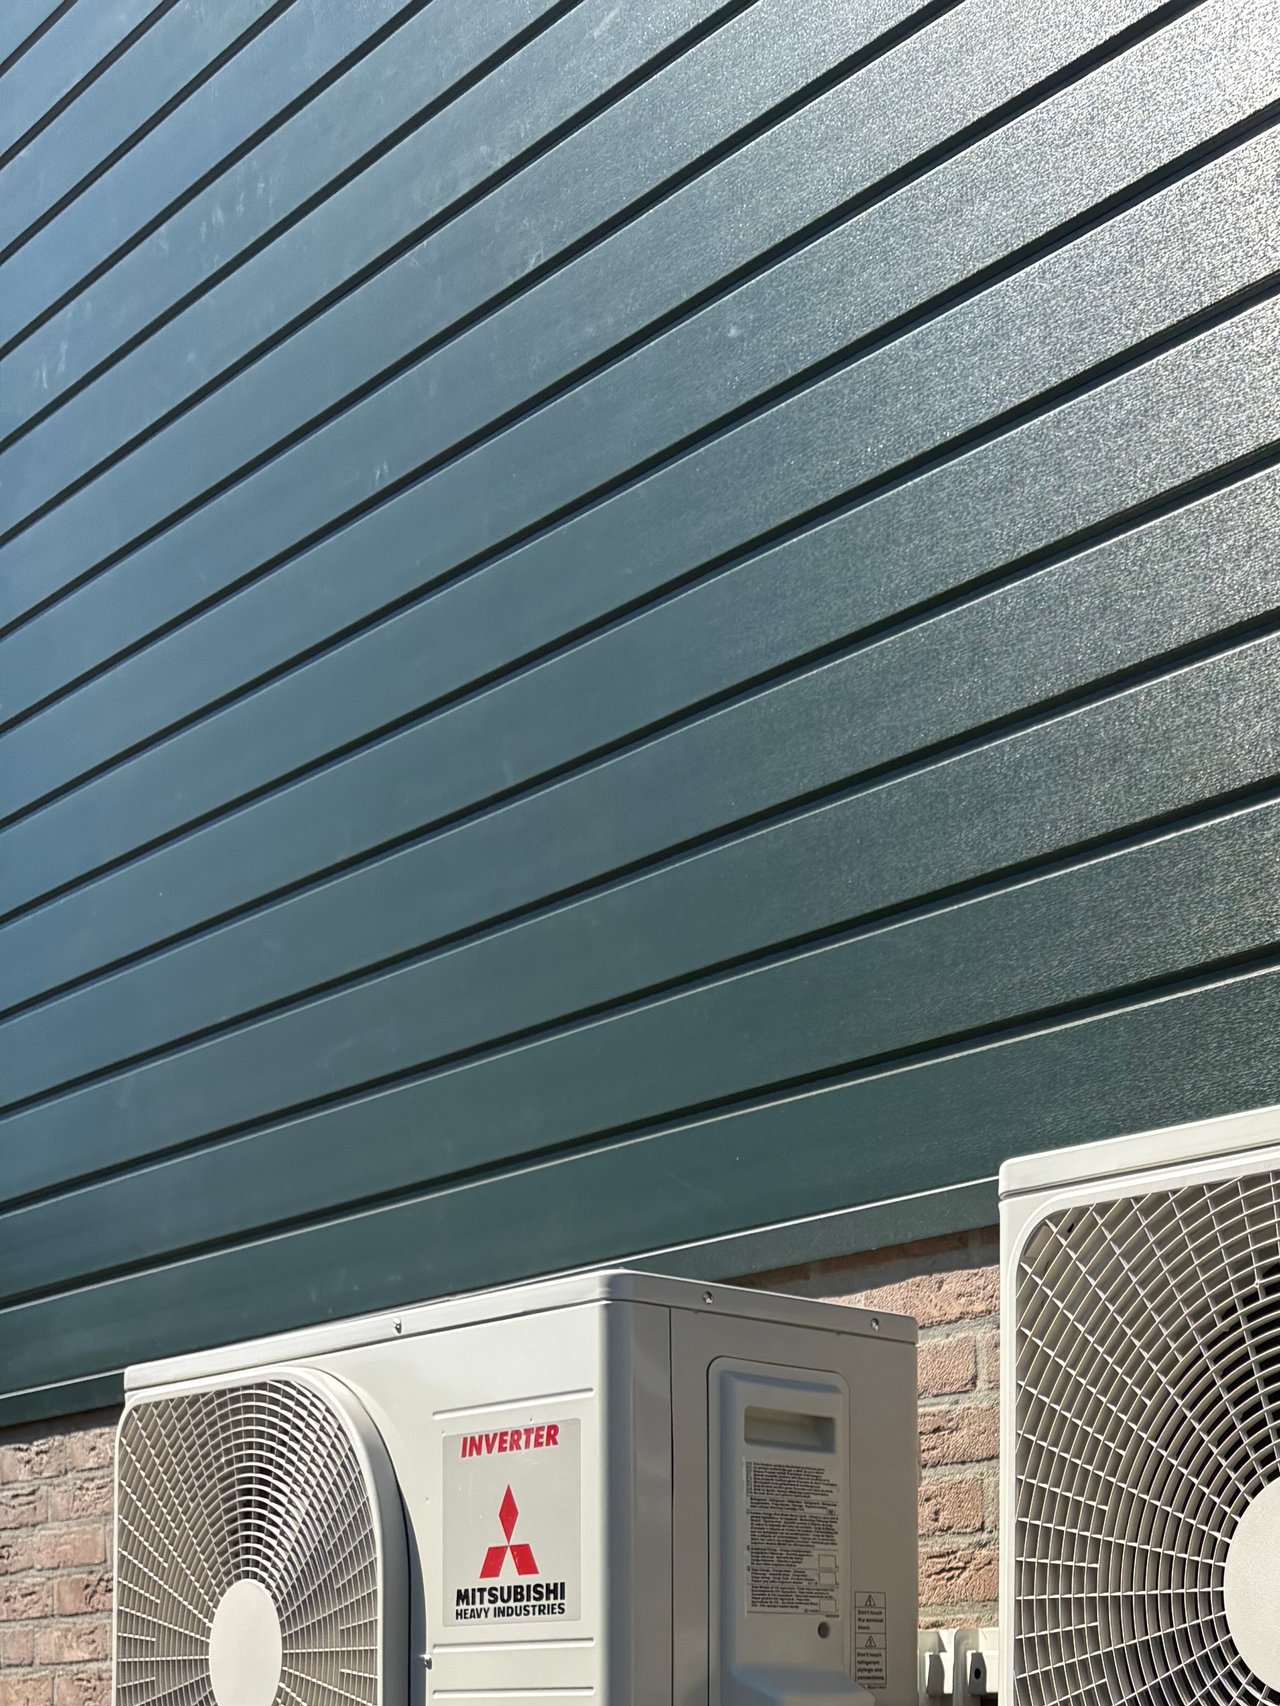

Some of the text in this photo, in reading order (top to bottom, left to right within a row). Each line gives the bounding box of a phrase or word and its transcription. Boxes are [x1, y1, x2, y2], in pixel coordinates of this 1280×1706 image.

[460, 1423, 560, 1458] INVERTER
[455, 1581, 567, 1607] MITSUBISHI
[455, 1602, 566, 1620] HEAVY INDUSTRIES
